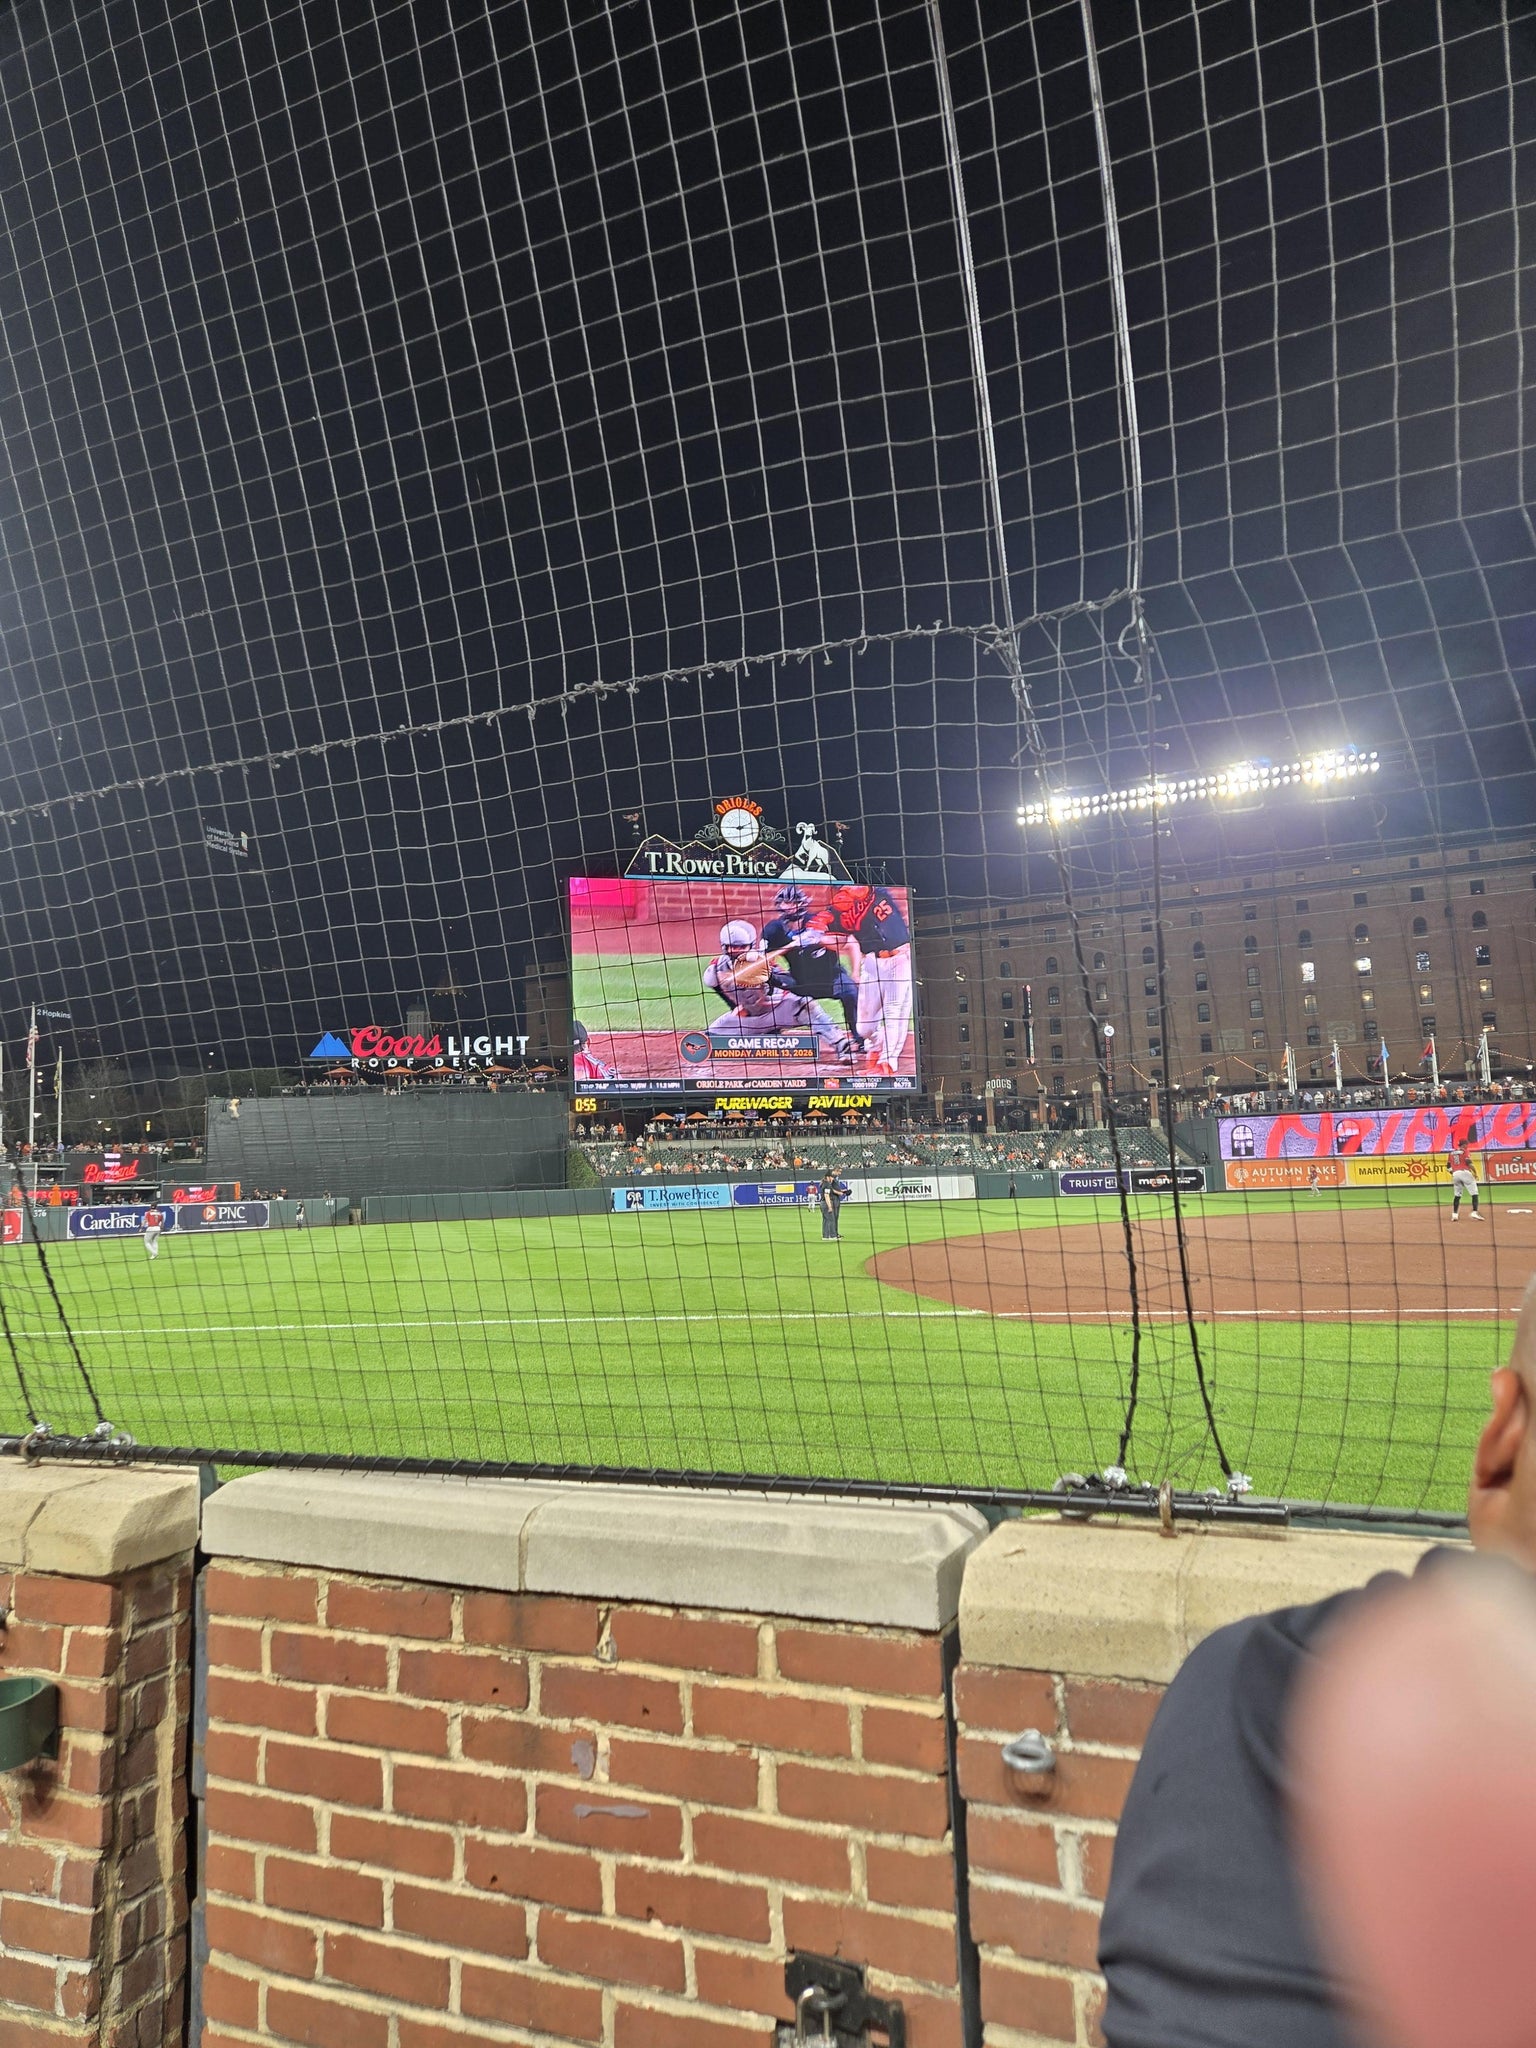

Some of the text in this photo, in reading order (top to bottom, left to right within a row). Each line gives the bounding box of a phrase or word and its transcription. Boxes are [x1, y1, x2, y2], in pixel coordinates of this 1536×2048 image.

[714, 796, 763, 817] ORIOLES
[873, 900, 893, 921] 25
[42, 1010, 72, 1019] Hopkins
[350, 1025, 530, 1057] Coors LIGHT
[728, 1037, 799, 1049] GAME RECAP
[755, 1049, 779, 1057] APRIL
[793, 1048, 813, 1057] 2026
[351, 1056, 494, 1068] ROOF DECK
[696, 1080, 724, 1089] ORIOLE
[725, 1080, 743, 1089] PARK
[752, 1079, 783, 1088] CAMDEN
[783, 1079, 807, 1088] YARDS
[715, 1094, 872, 1110] PUREWAGER PAVILION
[1252, 1167, 1303, 1177] AUTUMN
[1358, 1166, 1407, 1175] MARYLAND
[1068, 1179, 1104, 1188] TRUIST
[759, 1194, 794, 1204] MedStar
[217, 1206, 246, 1220] PNC
[80, 1212, 140, 1231] CareFirst
